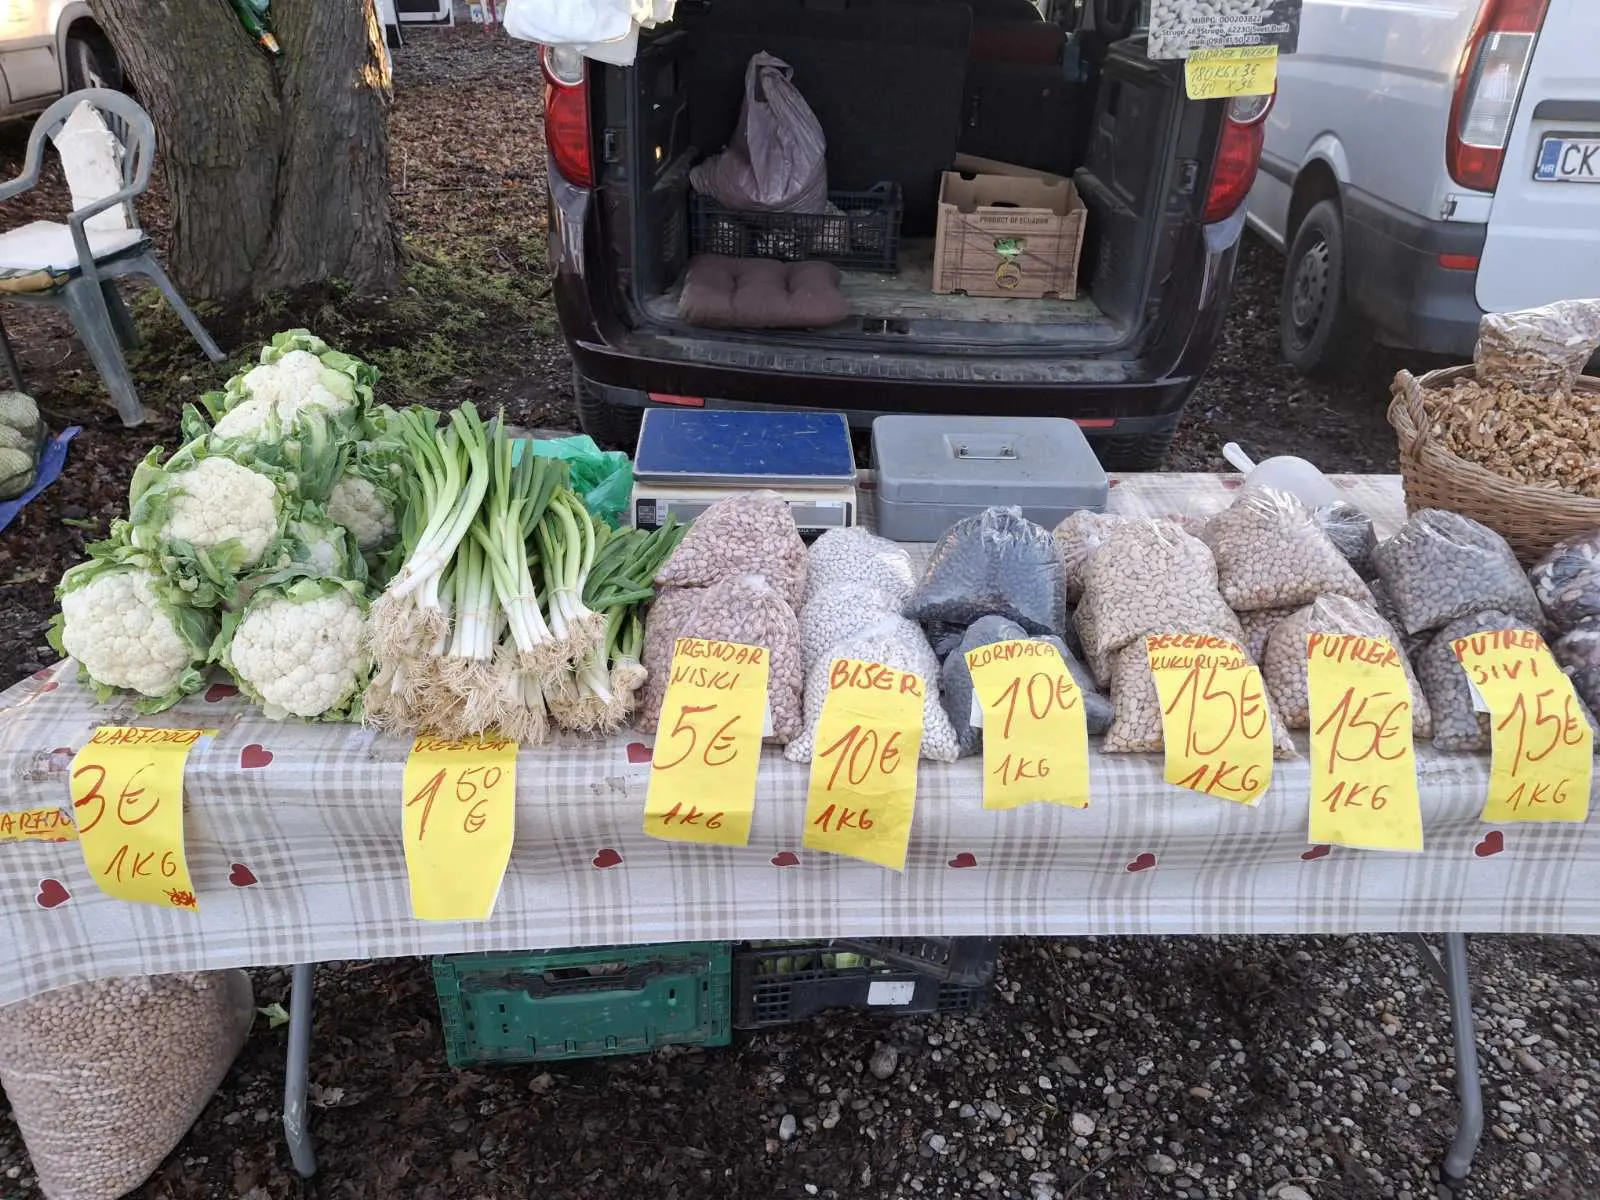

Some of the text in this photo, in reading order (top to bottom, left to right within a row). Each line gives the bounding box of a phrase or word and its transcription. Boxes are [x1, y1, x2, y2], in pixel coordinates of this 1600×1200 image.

[979, 216, 1049, 225] PRODUCT OF ECUADOR
[830, 659, 922, 697] BISER
[1473, 657, 1538, 686] SIVI
